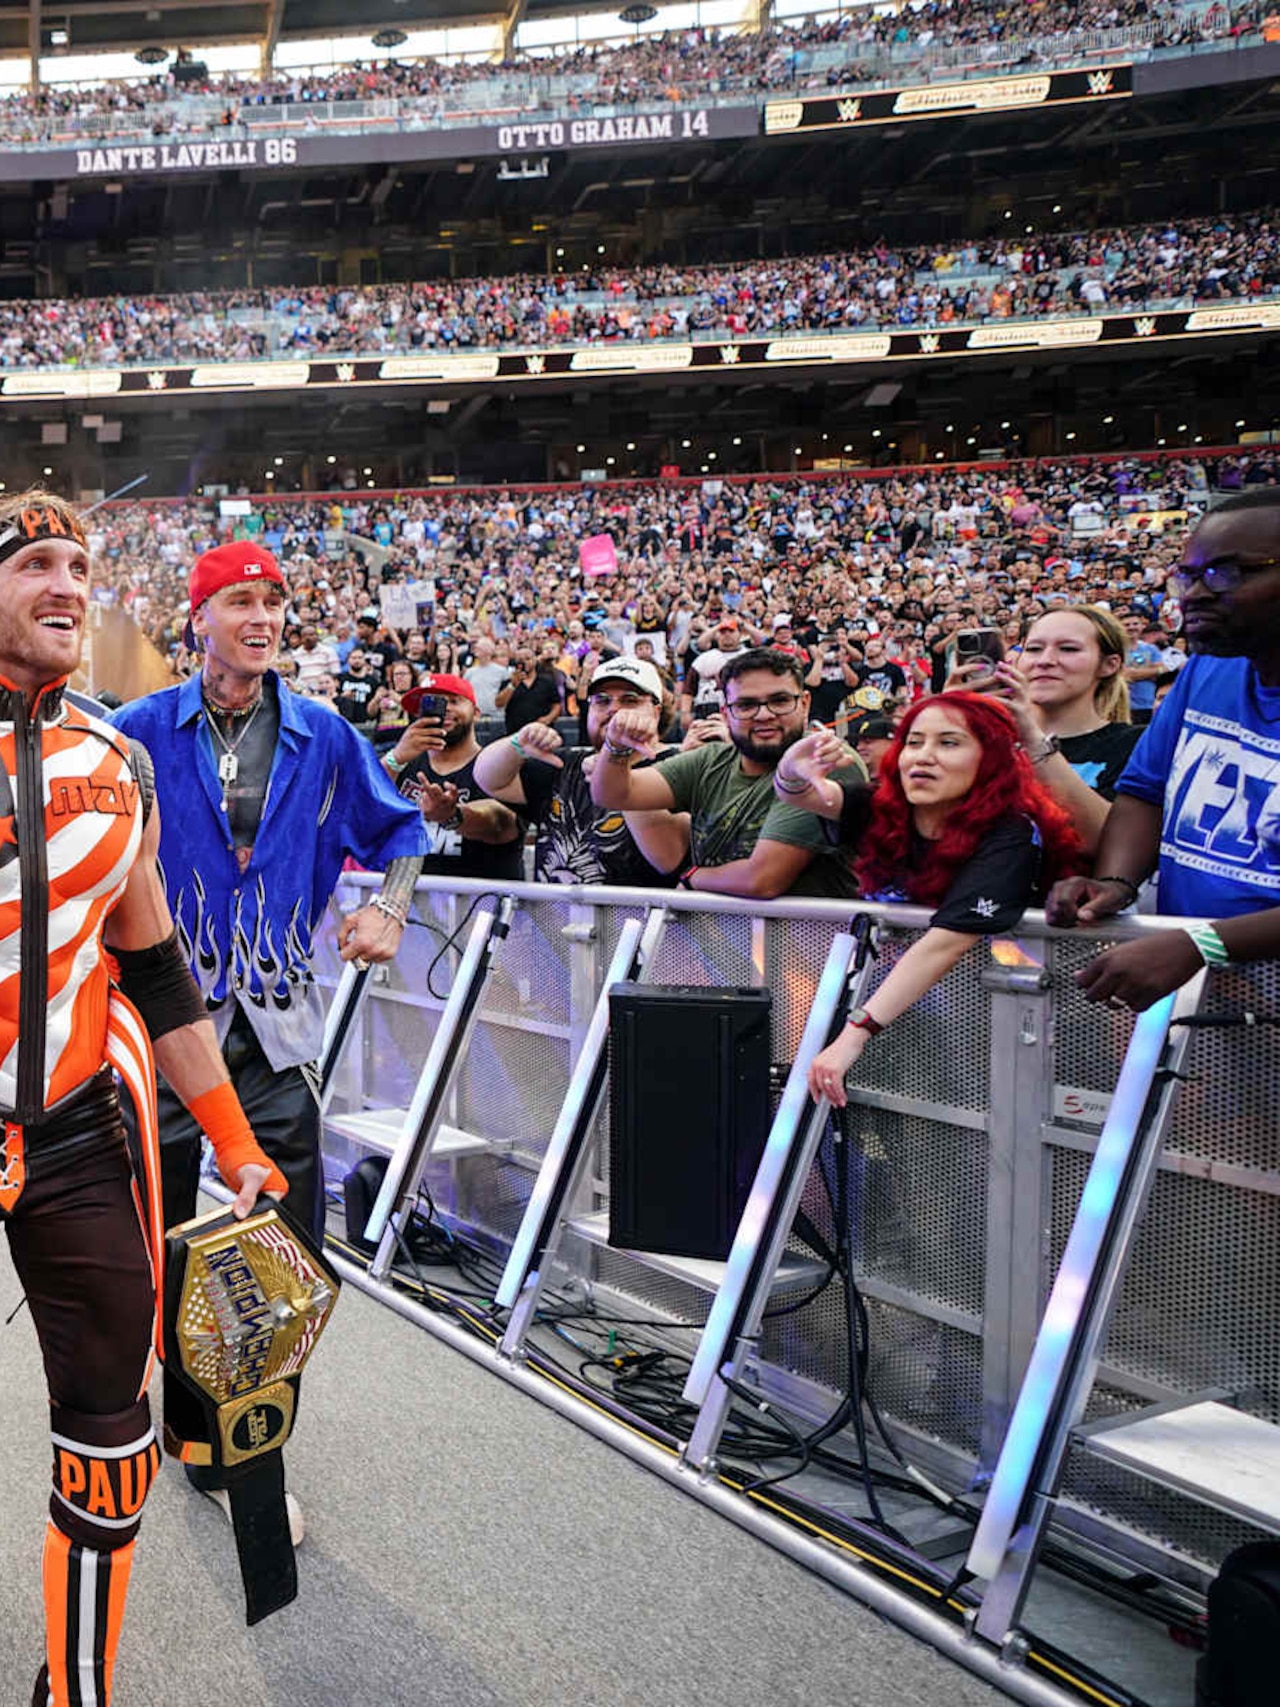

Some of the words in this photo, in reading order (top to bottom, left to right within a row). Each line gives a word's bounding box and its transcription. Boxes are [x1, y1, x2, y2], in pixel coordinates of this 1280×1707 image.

[498, 123, 564, 149] OTTO
[570, 114, 672, 143] GRAHAM
[682, 110, 709, 137] 14
[76, 147, 156, 172] DANTE
[161, 142, 256, 168] LAVELLI
[264, 138, 297, 164] 86
[207, 1243, 272, 1398] CHAMPION
